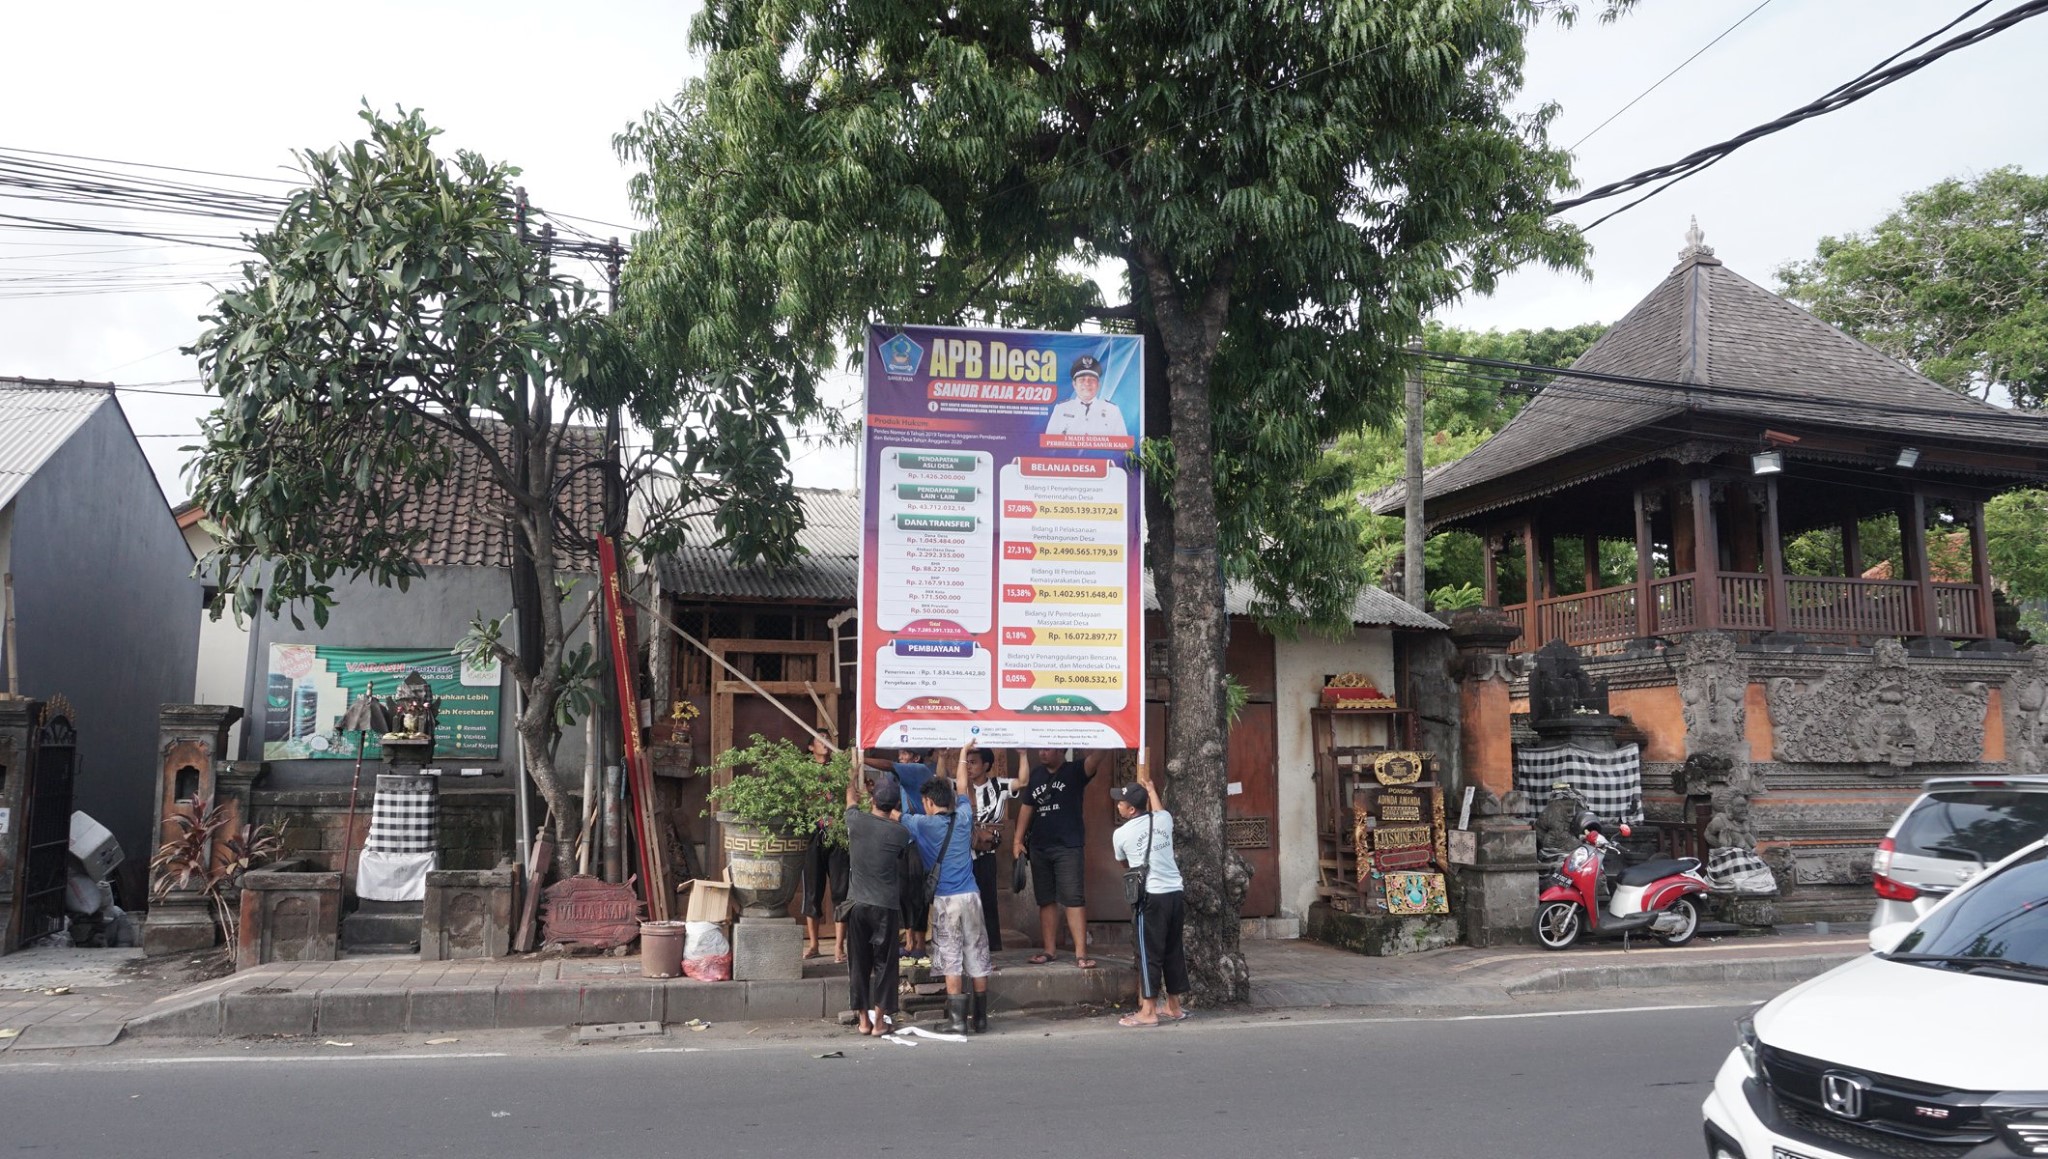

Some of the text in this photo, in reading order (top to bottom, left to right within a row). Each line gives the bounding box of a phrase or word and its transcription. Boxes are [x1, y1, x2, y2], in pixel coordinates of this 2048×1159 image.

[929, 339, 1056, 382] APB Desa
[933, 382, 1052, 401] SANUR KAJA 2020
[902, 418, 928, 426] Hukum
[956, 433, 979, 441] Anggaran
[1031, 463, 1096, 473] BELANJA DESA
[1024, 484, 1046, 492] Bidang
[1007, 504, 1118, 515] 57,08% Rp. 5.205.139.317,24
[904, 519, 970, 528] DANA TRANSFER
[1033, 534, 1078, 542] Pembangunan
[1007, 546, 1118, 556] 27,31% Rp. 2.490.565.179,39
[1006, 589, 1031, 597] 15,38%
[1054, 590, 1118, 599] 1.402.951.648,40
[1006, 631, 1117, 641] 0,18% Rp. 16.072.897,77
[908, 645, 960, 653] PEMBIAYAAN
[346, 662, 453, 673] VARASH INDONESIA
[1054, 675, 1066, 684] Rp.
[1068, 676, 1117, 684] 5.008.532,16
[463, 734, 487, 742] Vitalitas
[1380, 830, 1427, 845] JASMINE SPA
[558, 902, 596, 919] VILLA
